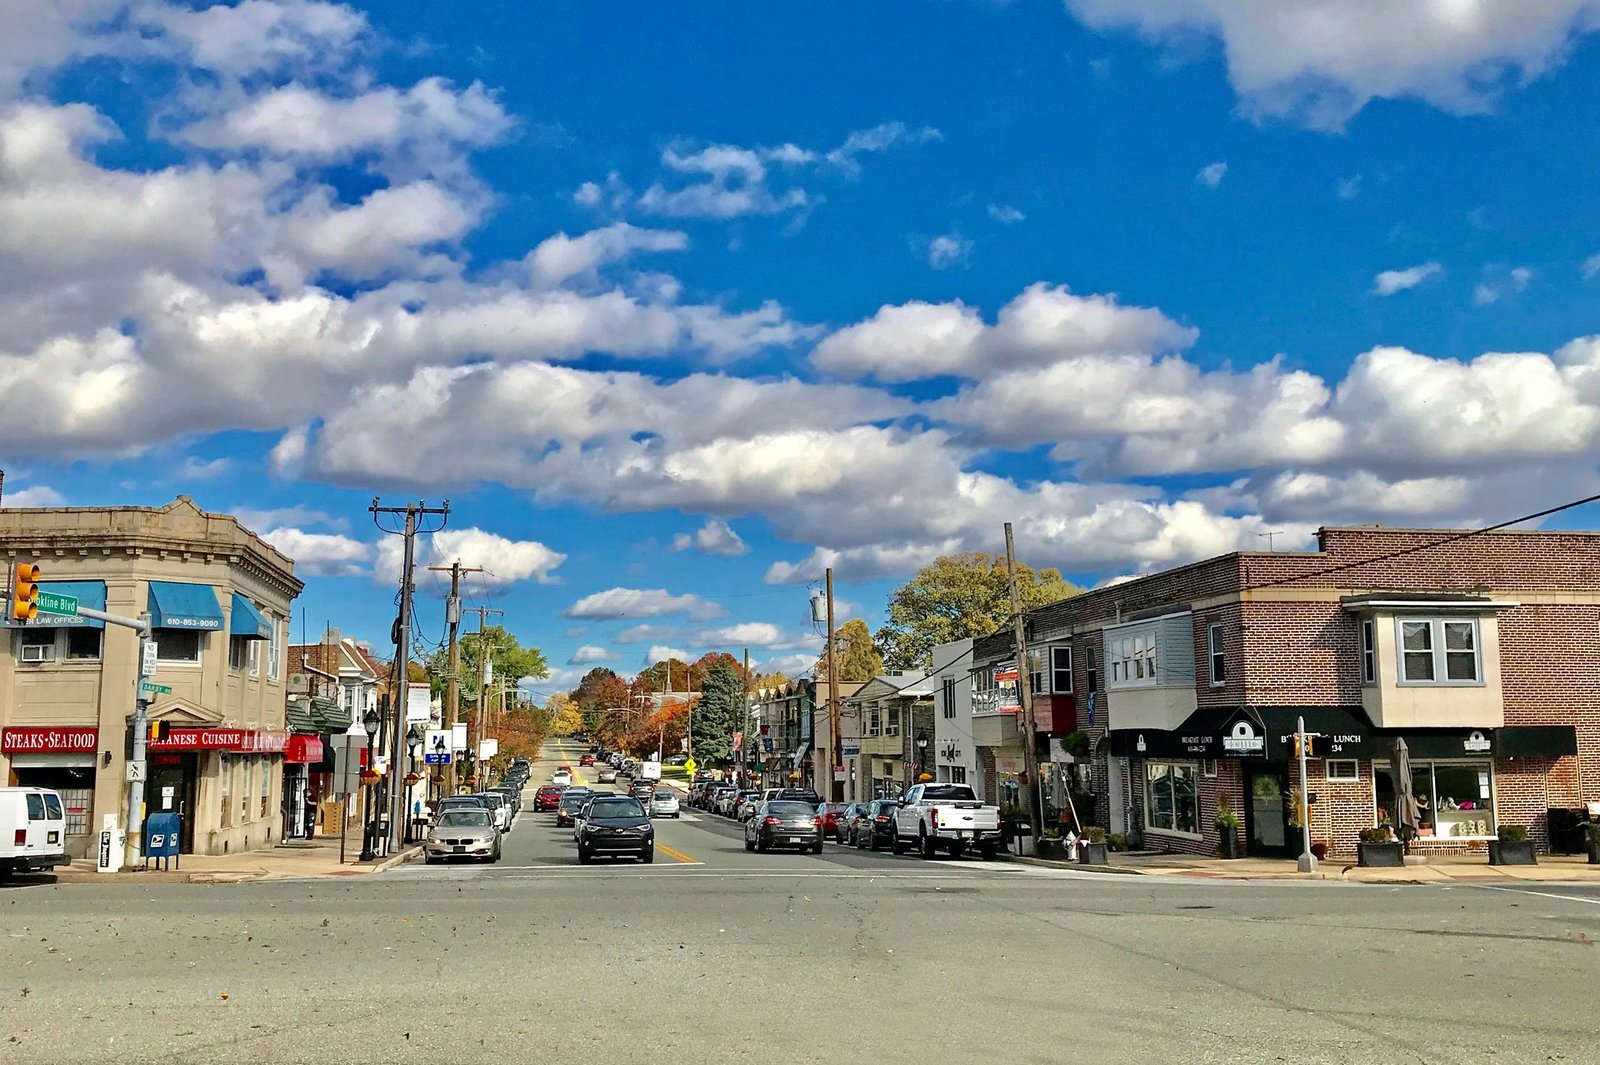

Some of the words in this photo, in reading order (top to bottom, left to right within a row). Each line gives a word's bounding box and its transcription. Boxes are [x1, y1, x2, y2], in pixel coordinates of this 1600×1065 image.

[60, 599, 75, 612] Blvd
[36, 617, 51, 625] LAW
[54, 616, 83, 624] OFFICES
[167, 618, 218, 627] 610-853-9090
[5, 732, 43, 748] STEAKS
[48, 732, 95, 748] SEAFOOD
[202, 732, 240, 745] CUISINE
[1333, 735, 1361, 743] LUNCH
